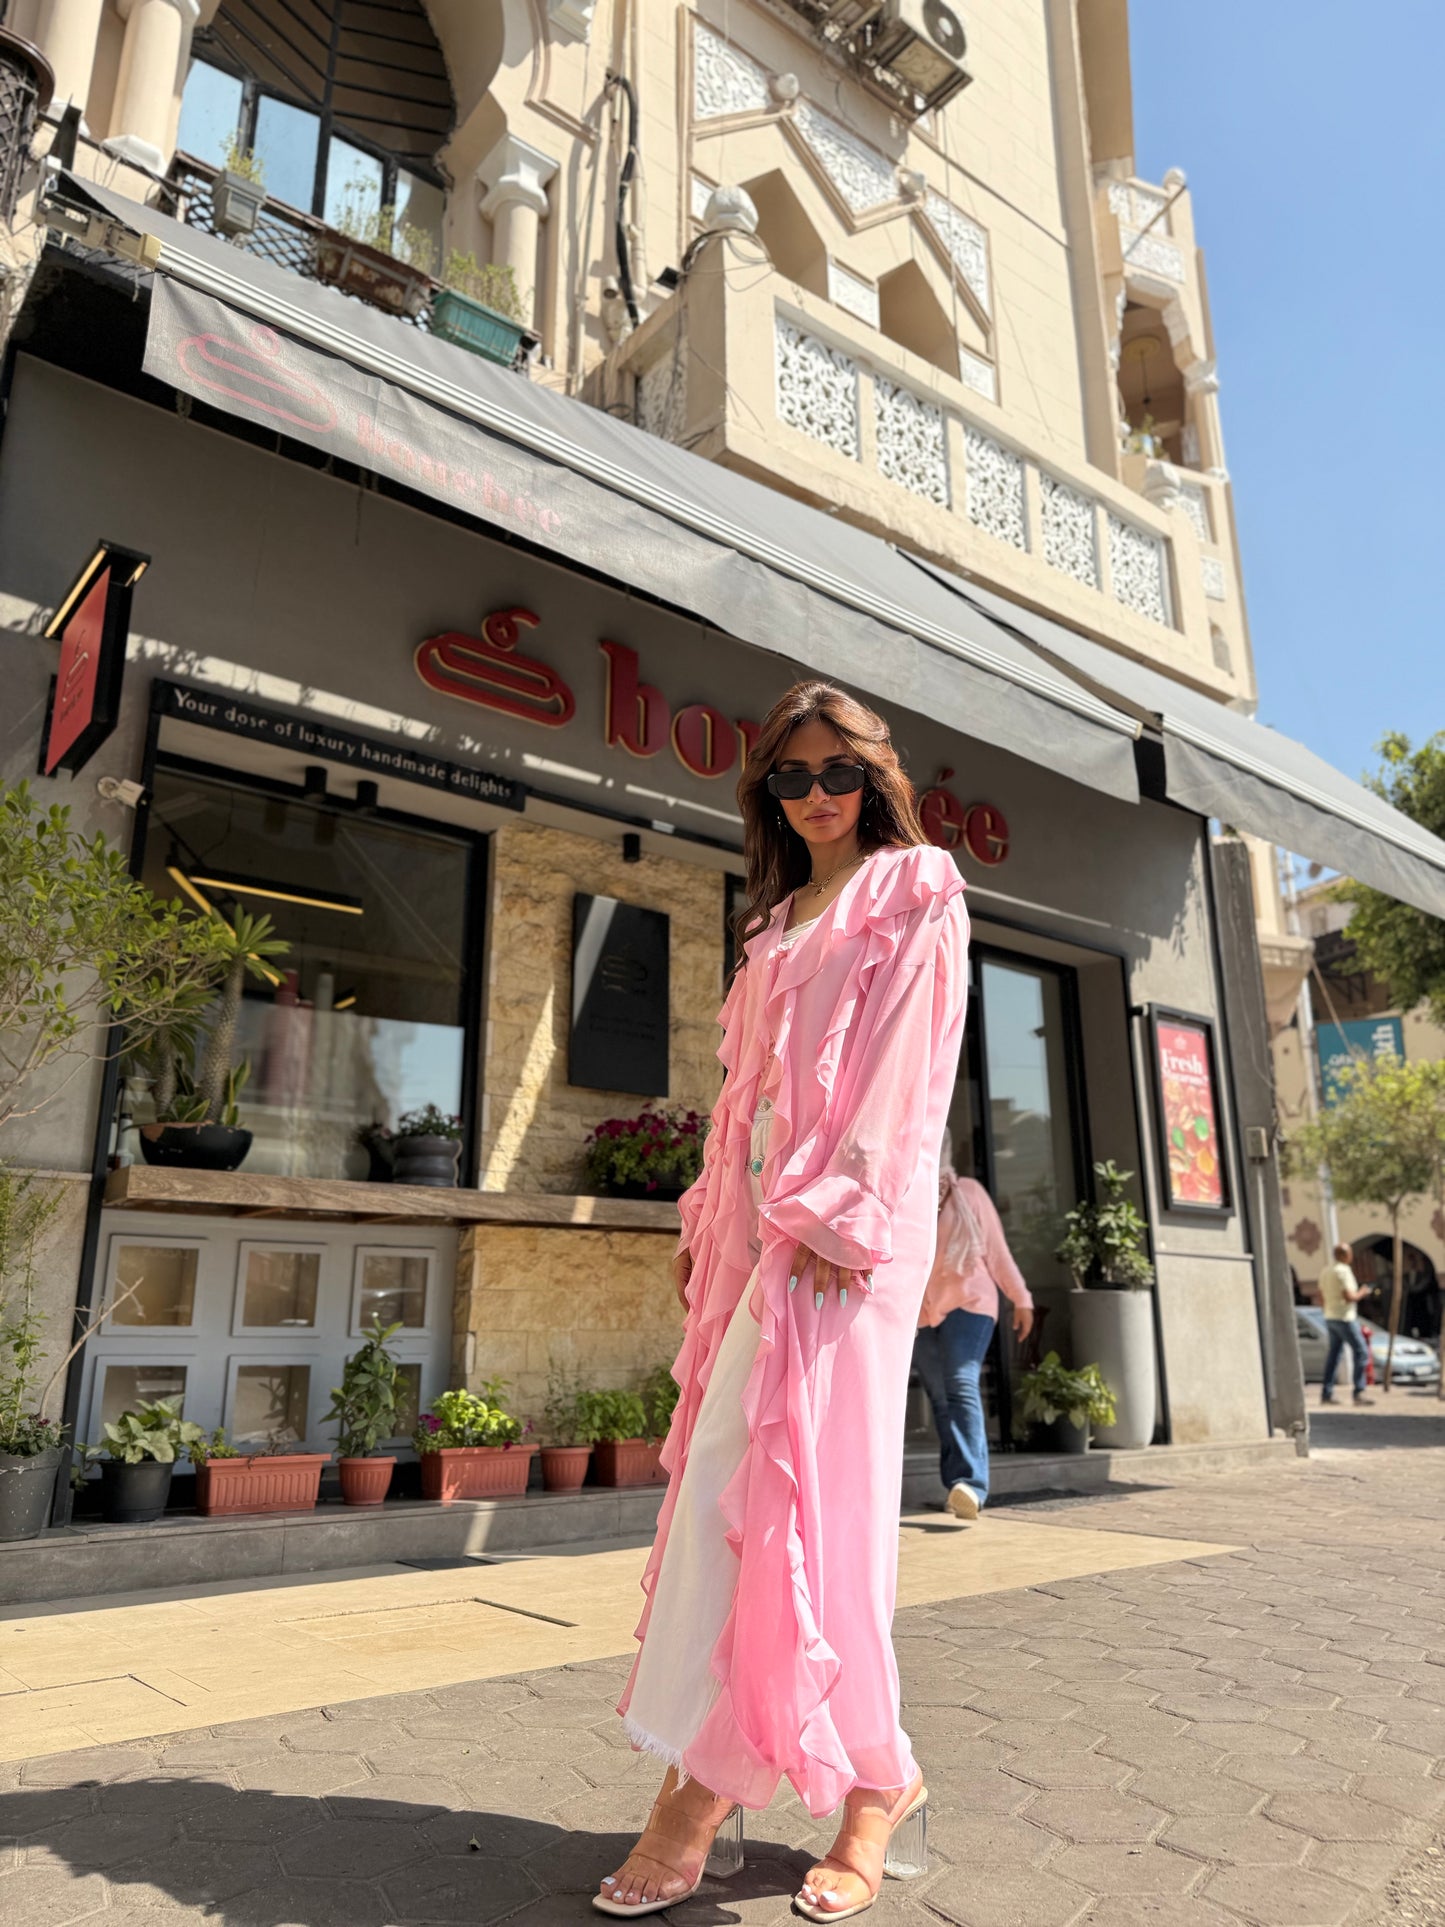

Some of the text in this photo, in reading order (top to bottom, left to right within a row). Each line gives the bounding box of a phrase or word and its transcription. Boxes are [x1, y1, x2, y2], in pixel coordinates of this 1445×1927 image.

[356, 414, 563, 537] bouchée
[174, 687, 512, 798] Your dose of luxury handmade delights
[599, 640, 1010, 868] boée
[1160, 1047, 1204, 1075] Fresh
